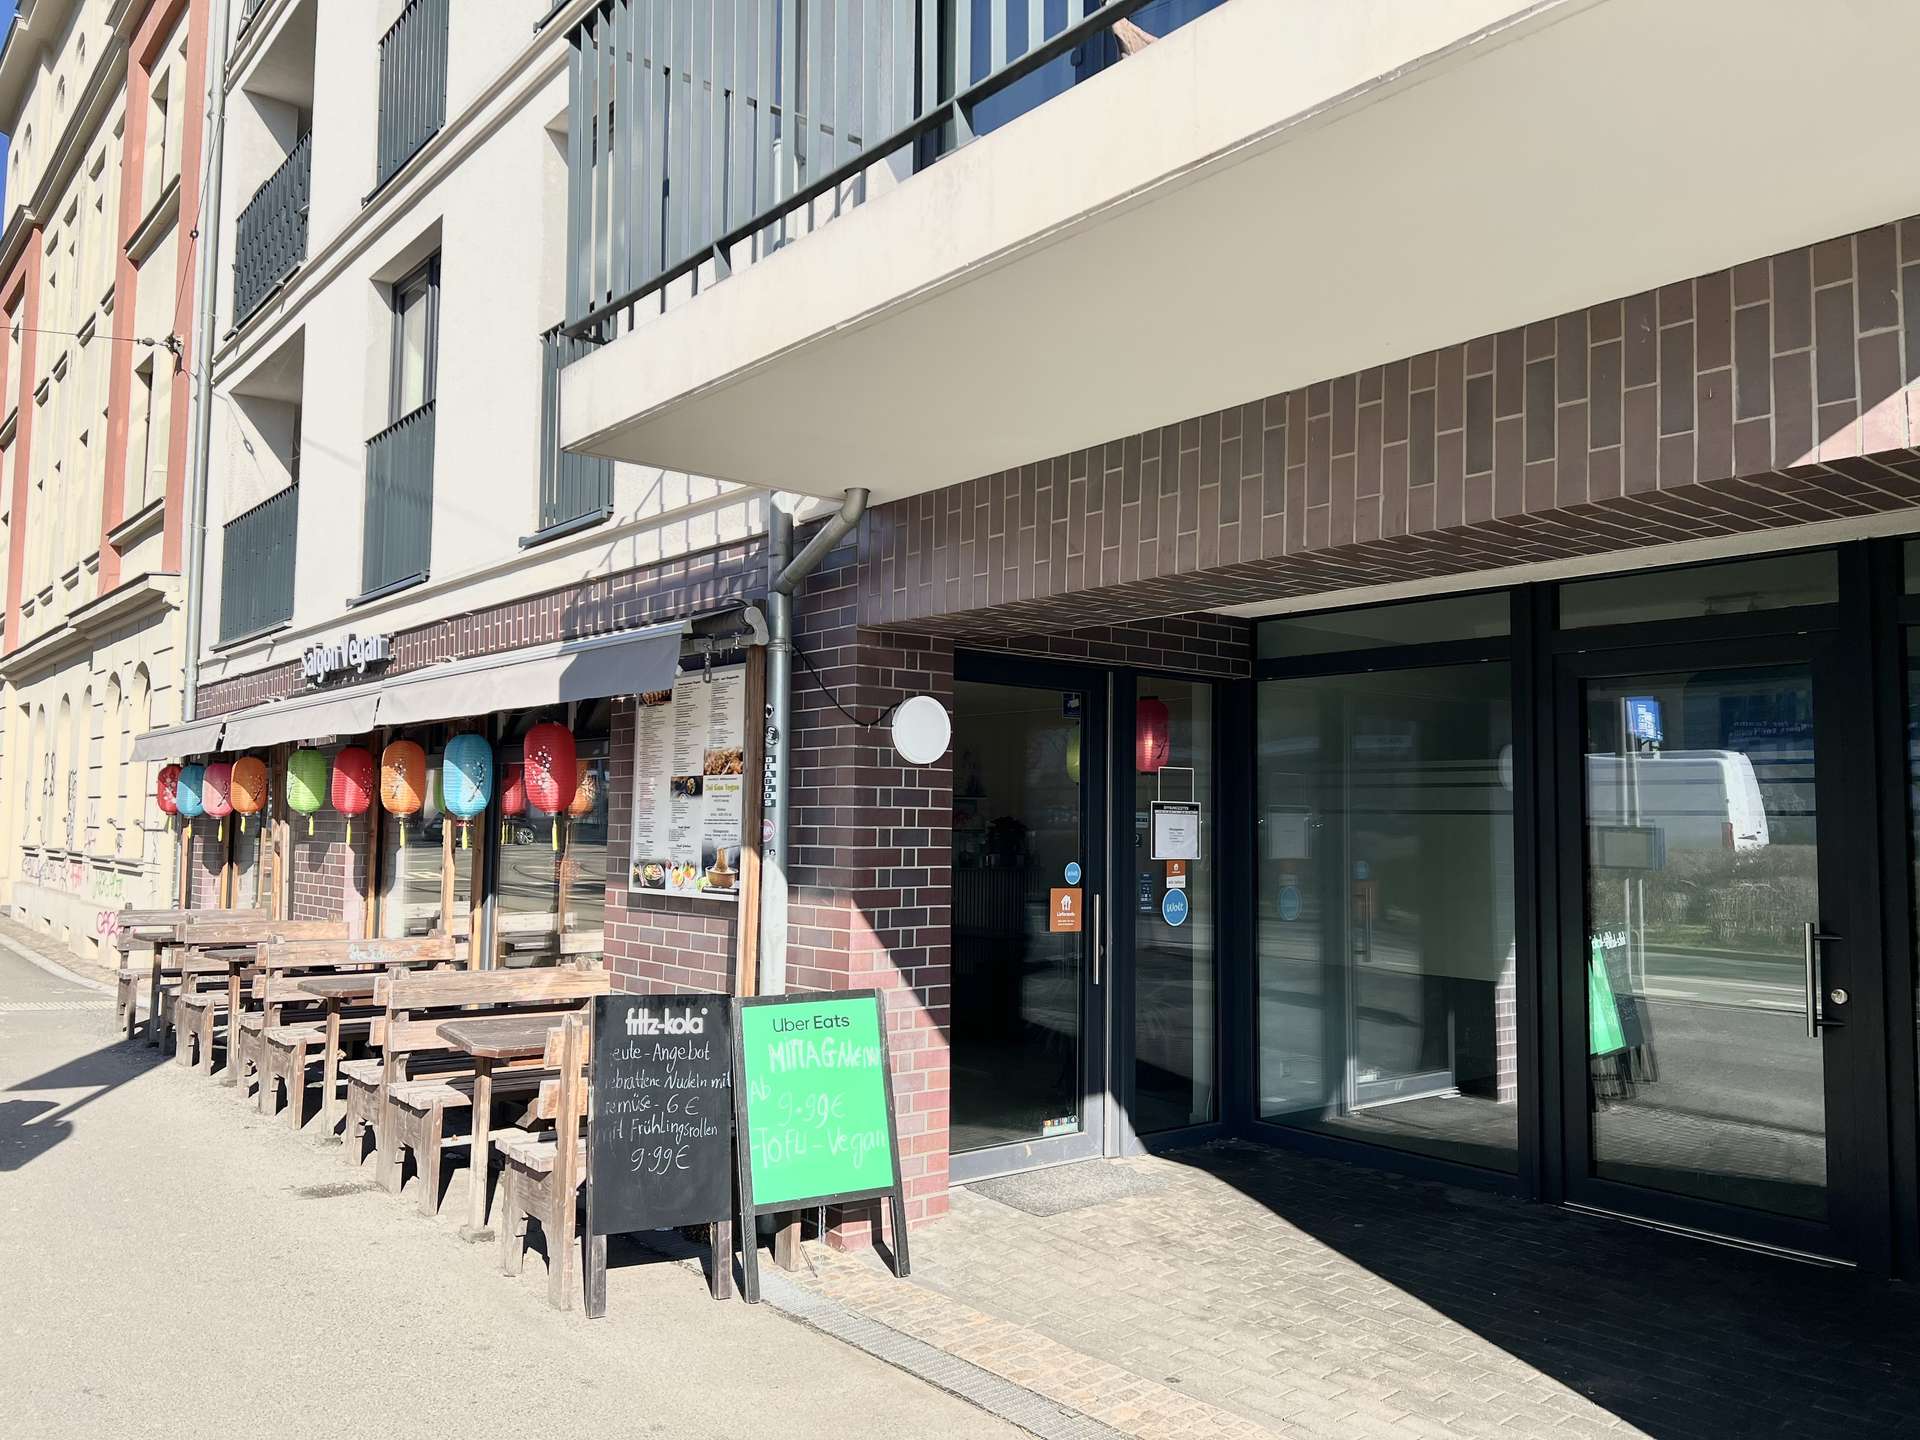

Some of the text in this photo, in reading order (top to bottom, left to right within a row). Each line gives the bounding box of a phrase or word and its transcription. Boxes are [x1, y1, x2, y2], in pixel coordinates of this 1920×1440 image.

[1166, 902, 1184, 912] Wolt
[772, 1014, 850, 1032] Uber Eats
[611, 1040, 642, 1061] eute
[711, 1072, 731, 1089] mit
[666, 1094, 679, 1113] 6
[685, 1096, 700, 1115] €
